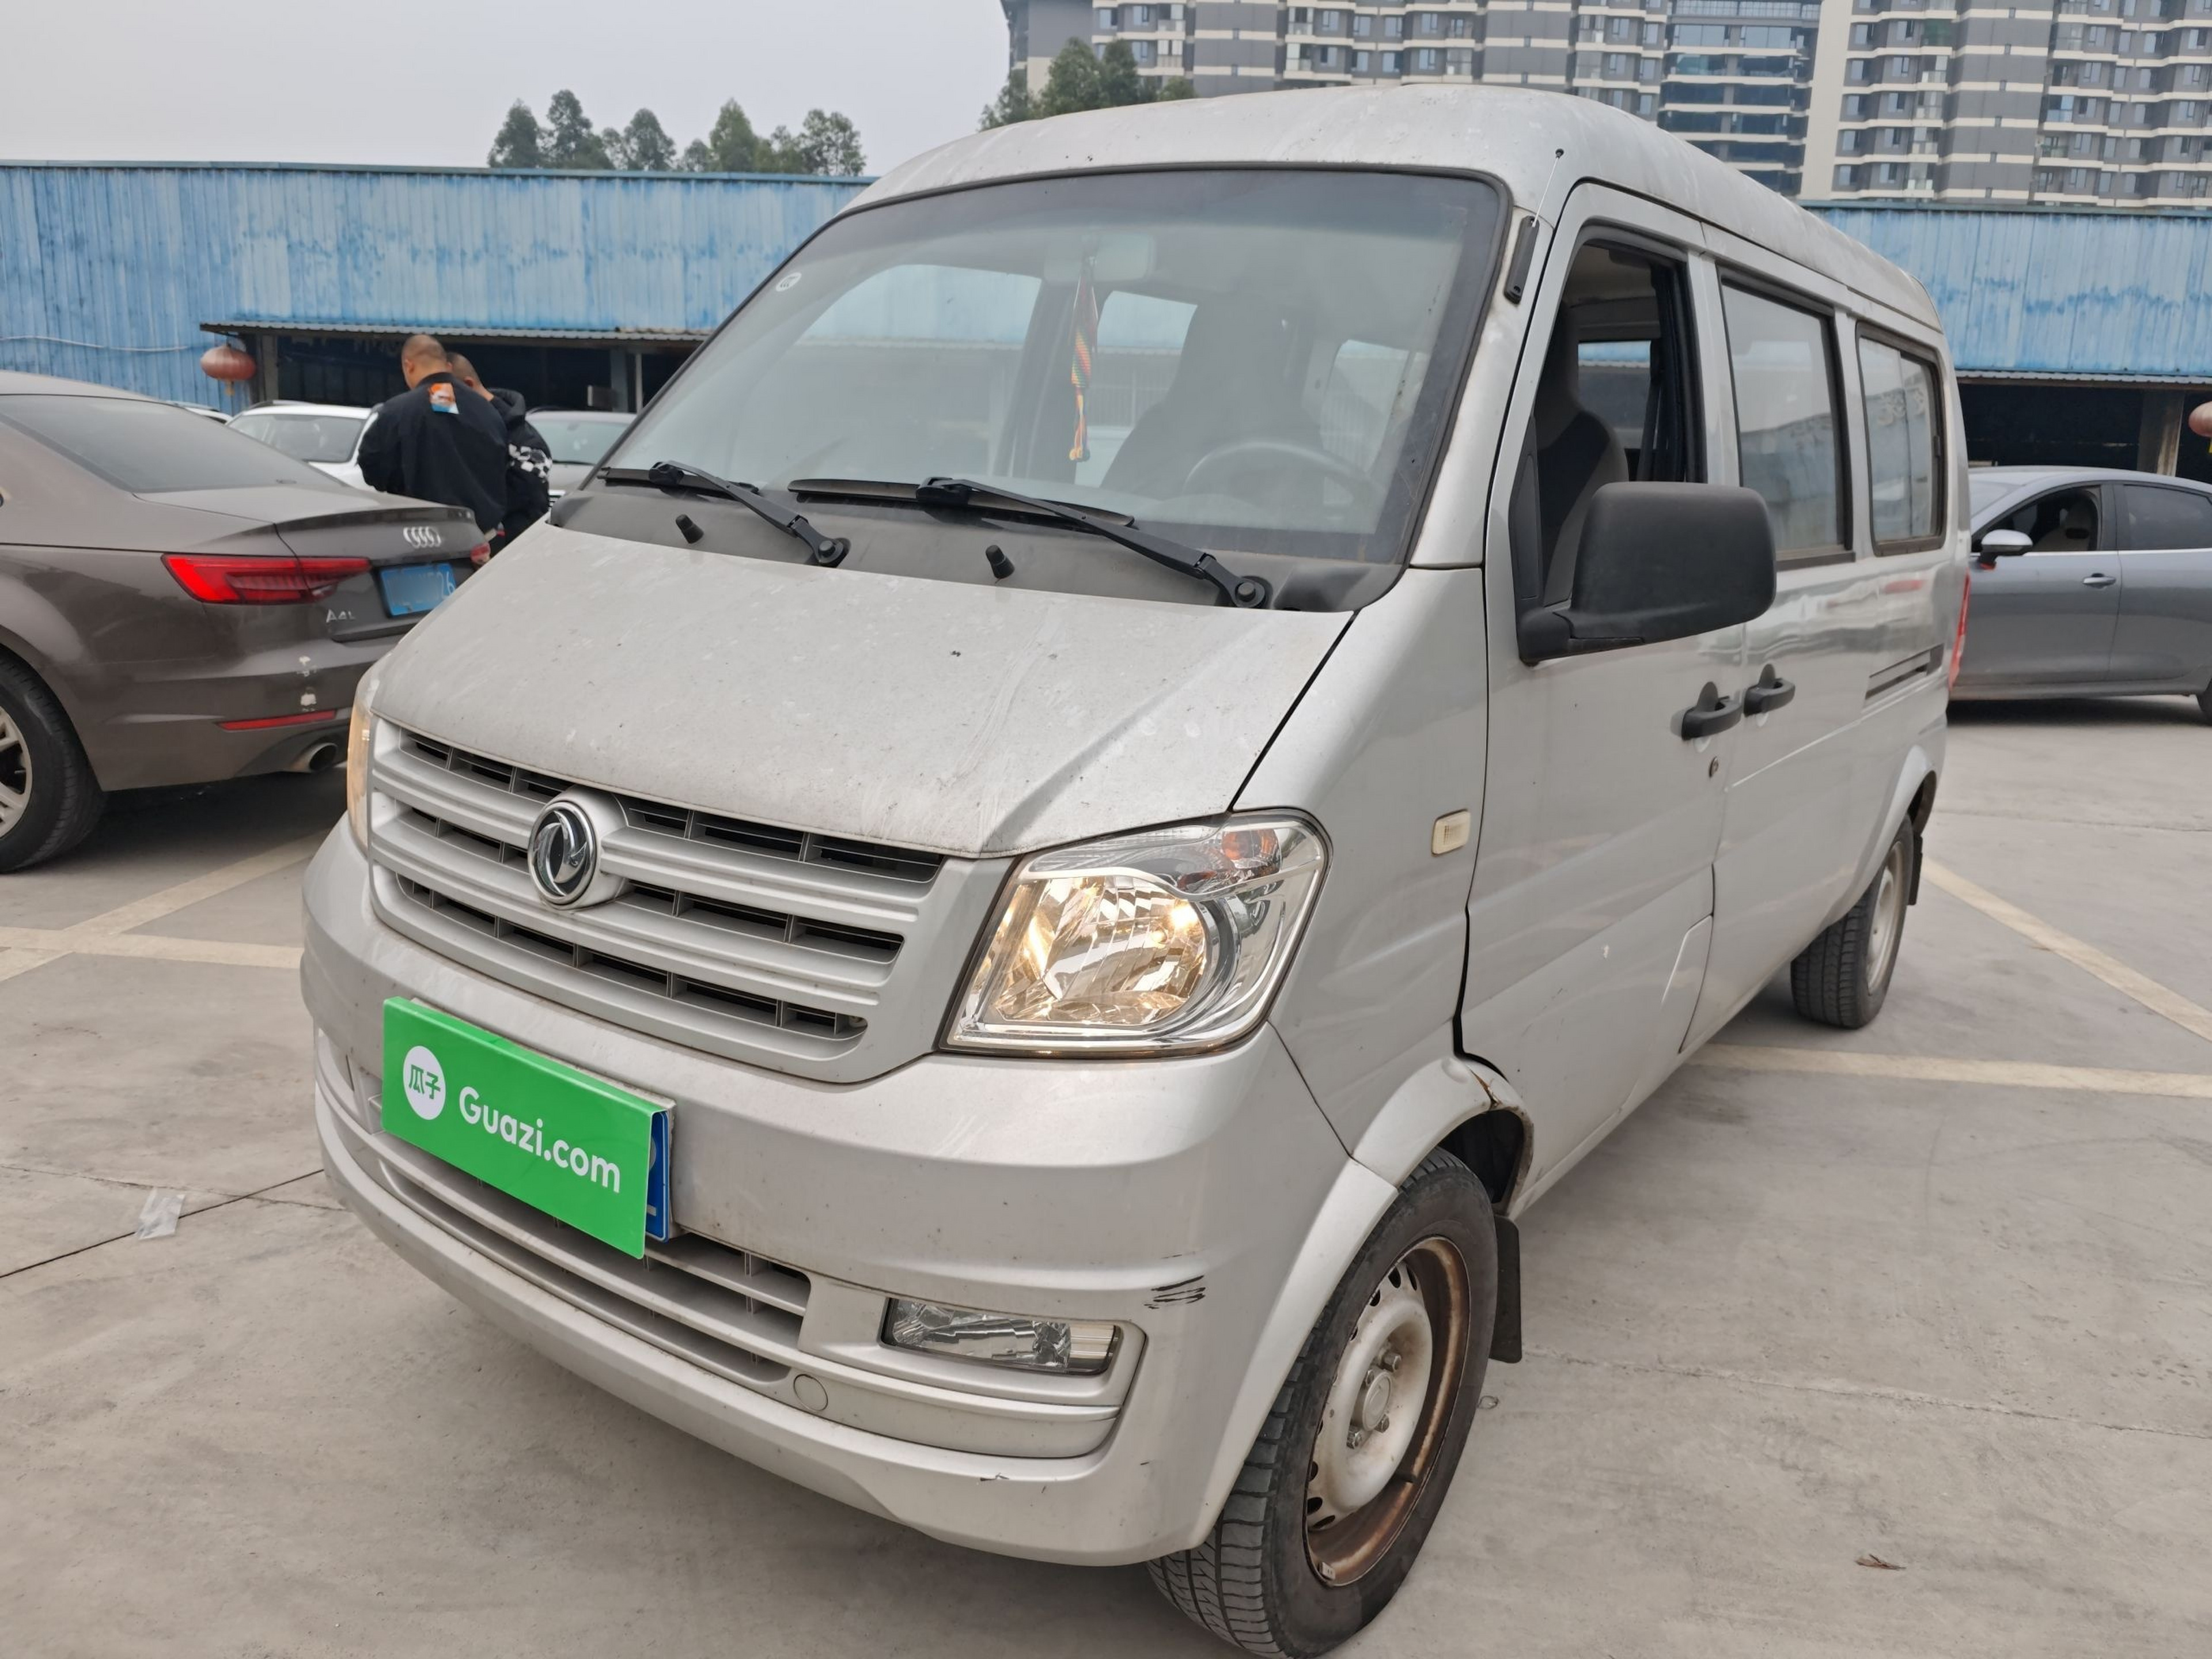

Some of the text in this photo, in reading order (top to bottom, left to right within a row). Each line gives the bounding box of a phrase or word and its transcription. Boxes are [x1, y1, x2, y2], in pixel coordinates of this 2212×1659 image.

[325, 608, 356, 623] A4L
[408, 1064, 441, 1100] 瓜子
[459, 1086, 620, 1193] Guazi.com
